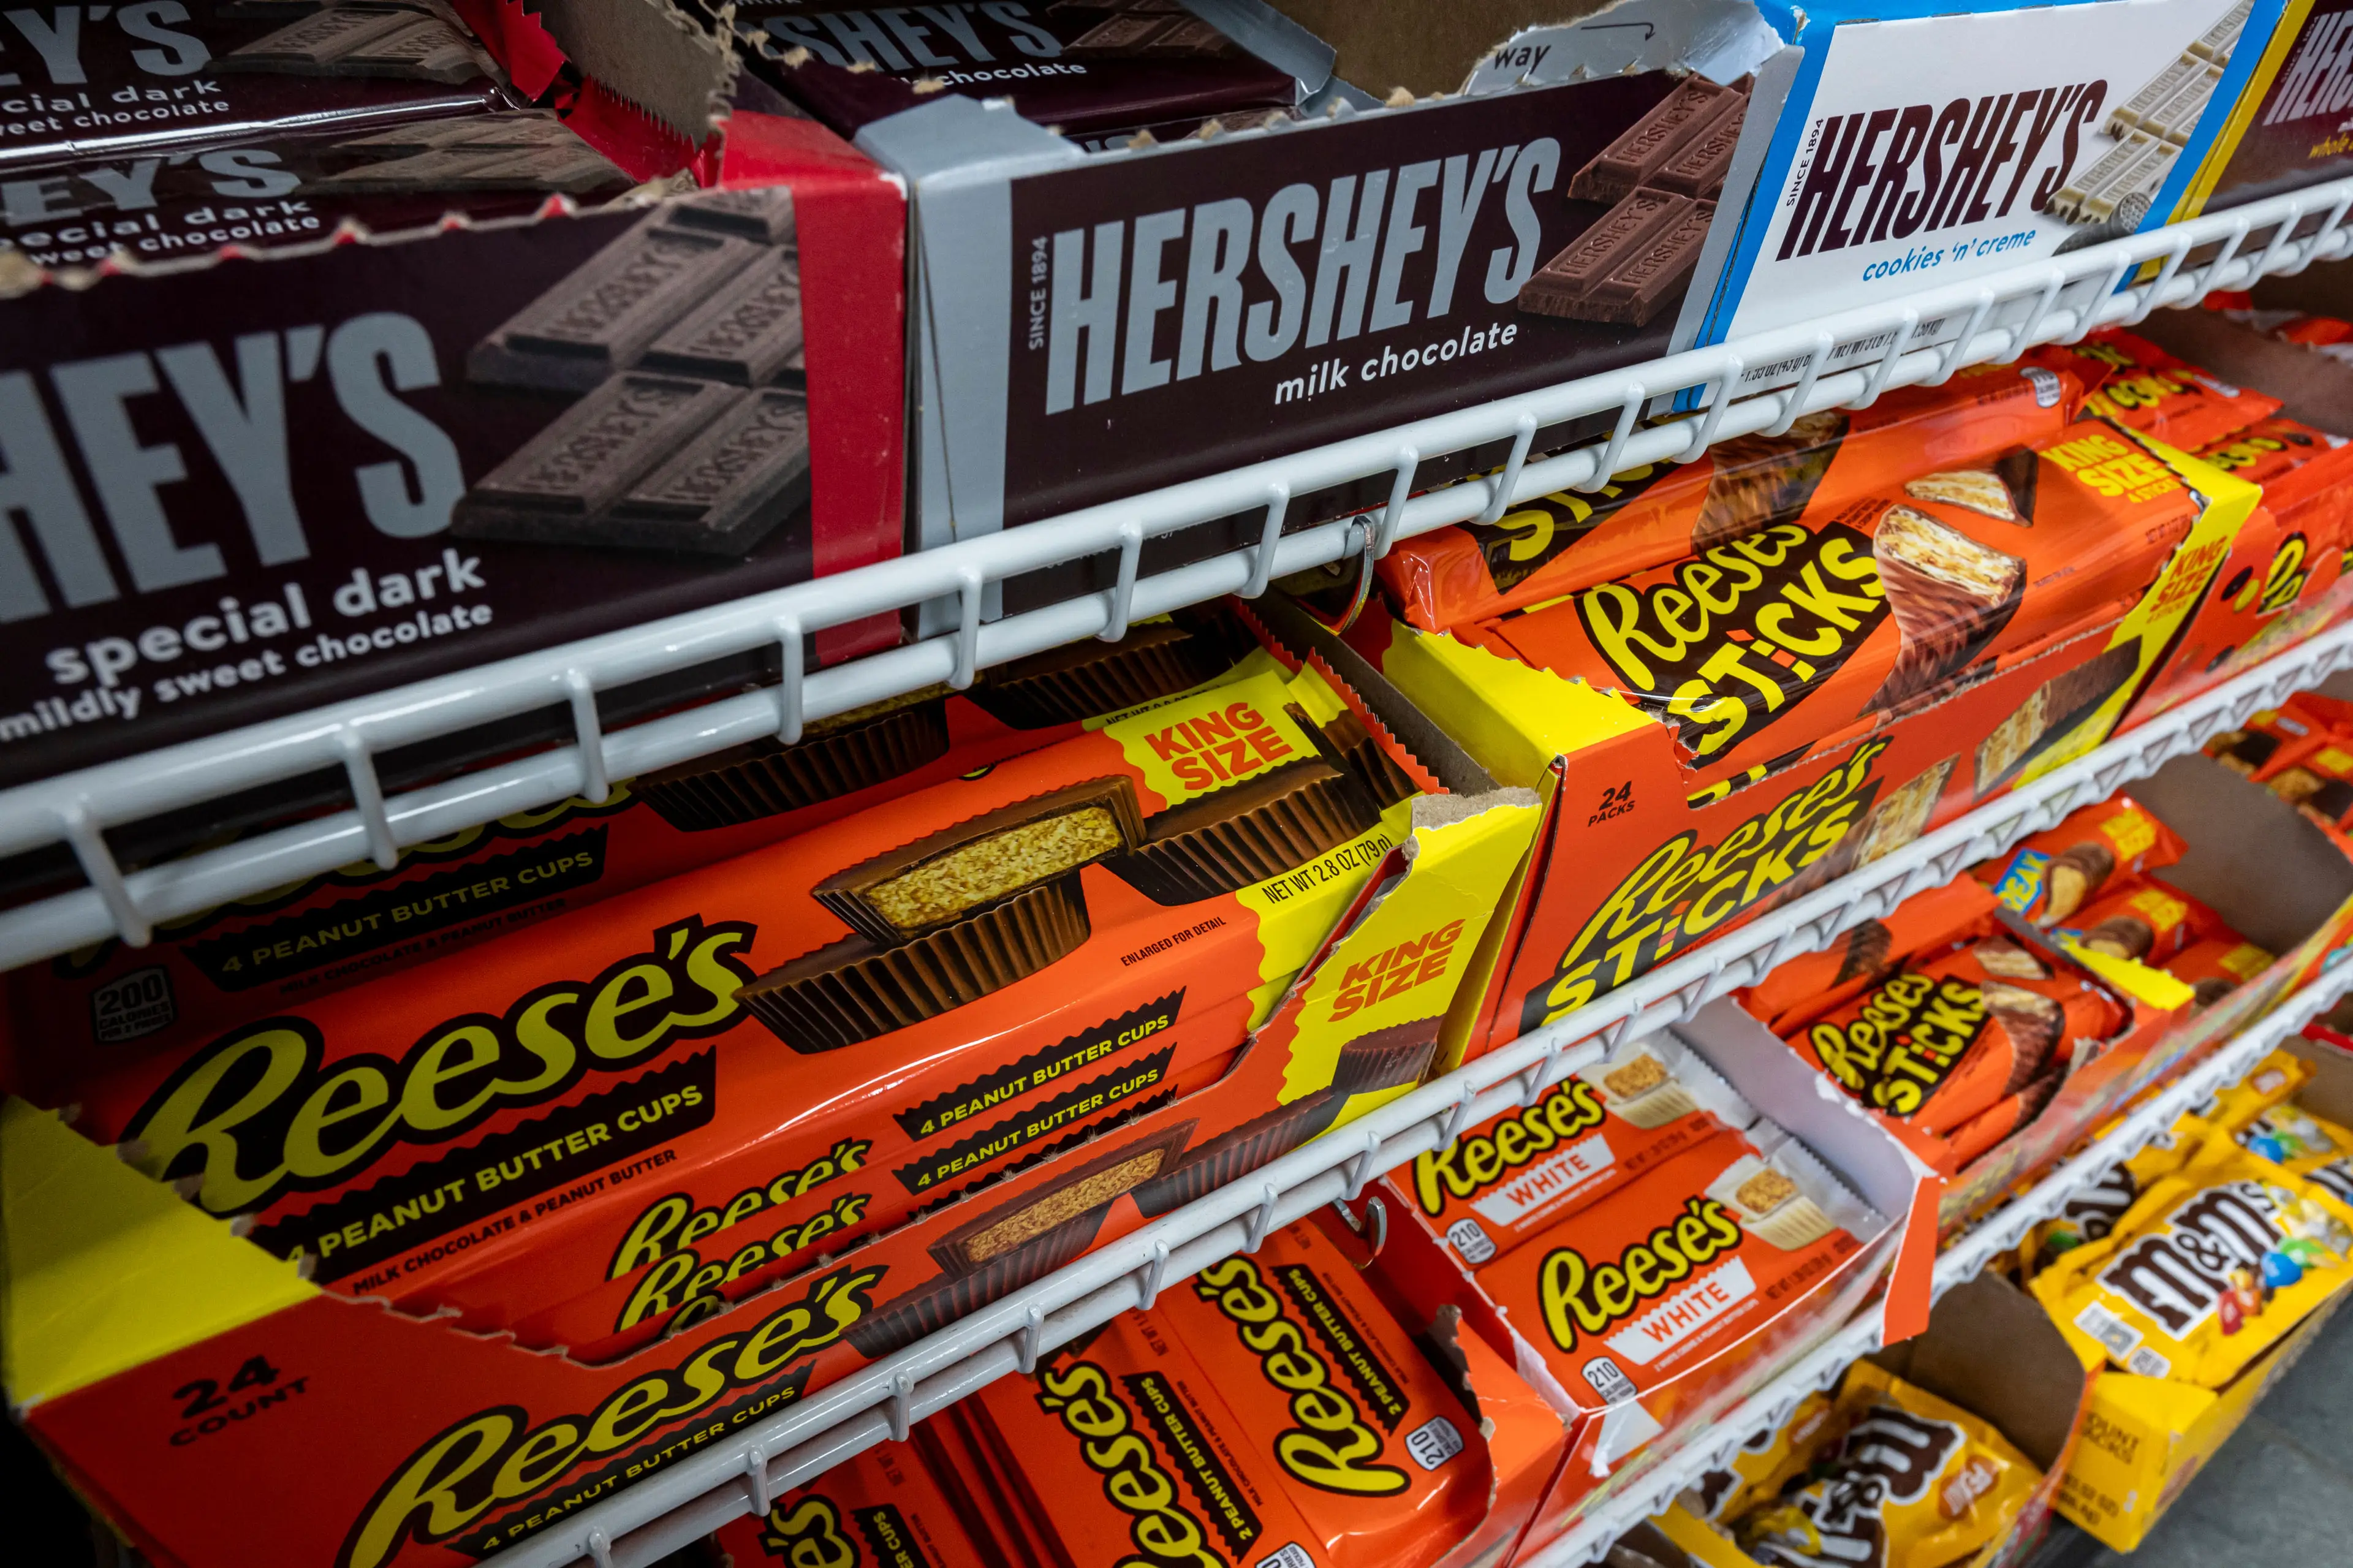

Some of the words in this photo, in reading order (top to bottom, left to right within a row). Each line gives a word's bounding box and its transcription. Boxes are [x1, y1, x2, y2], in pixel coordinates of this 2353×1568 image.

[0, 0, 212, 86] Y'S
[1493, 44, 1551, 74] way
[0, 93, 91, 116] cial
[112, 79, 222, 103] dark
[939, 62, 1087, 87] chocolate
[74, 99, 230, 127] chocolate
[1775, 79, 2109, 262] HERSHEY'S
[1786, 158, 1811, 207] SINCE
[1806, 118, 1825, 154] 1894
[138, 216, 320, 253] chocolate
[184, 200, 312, 225] dark
[1032, 237, 1049, 286] 1894
[1045, 137, 1561, 415] HERSHEY'S
[1862, 248, 1945, 282] cookies
[1979, 229, 2037, 258] creme
[1028, 288, 1050, 351] SINCE
[1274, 365, 1349, 405] milk
[1360, 322, 1518, 382] chocolate
[2038, 433, 2129, 473] KING
[2077, 452, 2168, 498] SIZE
[46, 583, 312, 687] special
[333, 548, 486, 616] dark
[0, 683, 142, 739] mildly
[154, 651, 286, 703] sweet
[295, 602, 493, 669] chocolate
[1144, 702, 1266, 762] KING
[1170, 725, 1294, 791] SIZE
[1588, 800, 1635, 828] PACKS
[1598, 781, 1632, 811] 24
[1261, 879, 1294, 904] NET
[1288, 869, 1317, 893] WT
[1313, 858, 1340, 883] 2.8
[1335, 849, 1360, 871] OZ
[1563, 740, 1883, 969] Reese's
[221, 954, 243, 973] 4
[252, 913, 383, 967] PEANUT
[390, 877, 512, 922] BUTTER
[516, 852, 594, 885] CUPS
[1120, 936, 1168, 968] ENLARGED
[1170, 927, 1192, 950] FOR
[1192, 916, 1227, 942] DETAIL
[1328, 944, 1455, 1023] SIZE
[1338, 918, 1466, 991] KING
[99, 973, 164, 1015] 200
[143, 927, 743, 1213] Reese's
[920, 1119, 935, 1134] 4
[941, 1076, 1028, 1127] PEANUT
[1033, 1039, 1112, 1086] BUTTER
[1118, 1015, 1169, 1047] CUPS
[917, 1173, 931, 1187] 4
[938, 1131, 1021, 1180] PEANUT
[1027, 1094, 1104, 1138] BUTTER
[1108, 1069, 1158, 1099] CUPS
[1418, 1081, 1604, 1214] Reese's
[310, 1183, 466, 1263] PEANUT
[475, 1123, 613, 1190] BUTTER
[616, 1084, 704, 1133] CUPS
[1506, 1153, 1591, 1208] WHITE
[352, 1261, 404, 1295] MILK
[401, 1221, 516, 1275] CHOCOLATE
[519, 1210, 531, 1225] &
[534, 1173, 612, 1218] PEANUT
[609, 1147, 678, 1186] BUTTER
[612, 1143, 866, 1281] Reese's
[1450, 1222, 1481, 1248] 210
[1289, 1268, 1317, 1302] CUPS
[1543, 1200, 1739, 1349] Reese's
[1313, 1301, 1355, 1352] BUTTER
[1642, 1281, 1730, 1343] WHITE
[172, 1354, 281, 1420] 24
[1140, 1376, 1171, 1414] CUPS
[1199, 1258, 1406, 1492] Reese's
[1348, 1351, 1393, 1405] PEANUT
[1588, 1361, 1619, 1388] 210
[169, 1376, 309, 1447] COUNT
[350, 1273, 876, 1568] Reese's
[1387, 1401, 1402, 1416] 2
[482, 1534, 502, 1553] 4
[506, 1475, 616, 1535] PEANUT
[624, 1422, 726, 1479] BUTTER
[731, 1385, 795, 1425] CUPS
[1164, 1411, 1207, 1471] BUTTER
[1411, 1431, 1446, 1465] 210
[873, 1510, 901, 1551] CUPS
[1199, 1469, 1248, 1531] PEANUT
[1237, 1527, 1254, 1541] 2
